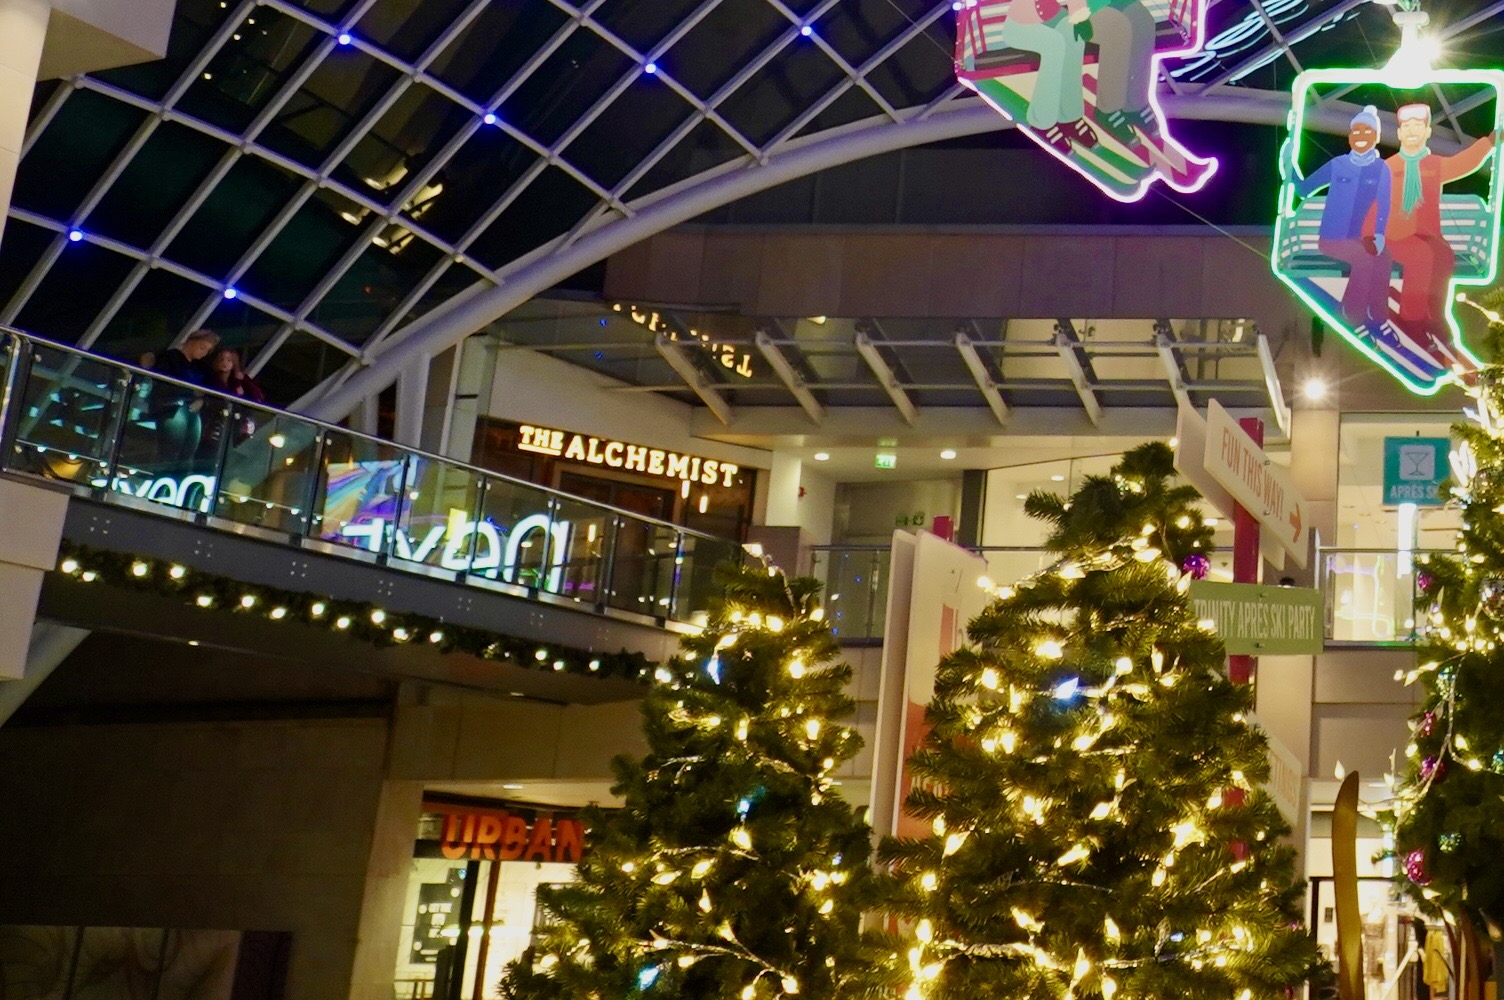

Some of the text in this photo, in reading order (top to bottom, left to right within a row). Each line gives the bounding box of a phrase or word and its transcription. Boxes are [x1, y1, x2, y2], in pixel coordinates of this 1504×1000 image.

[519, 425, 738, 487] THE ALCHEMIST
[1222, 426, 1284, 521] FUN THIS WAY!
[1271, 603, 1286, 639] SKI
[1288, 604, 1316, 640] PARTY
[441, 813, 585, 862] URBAN
